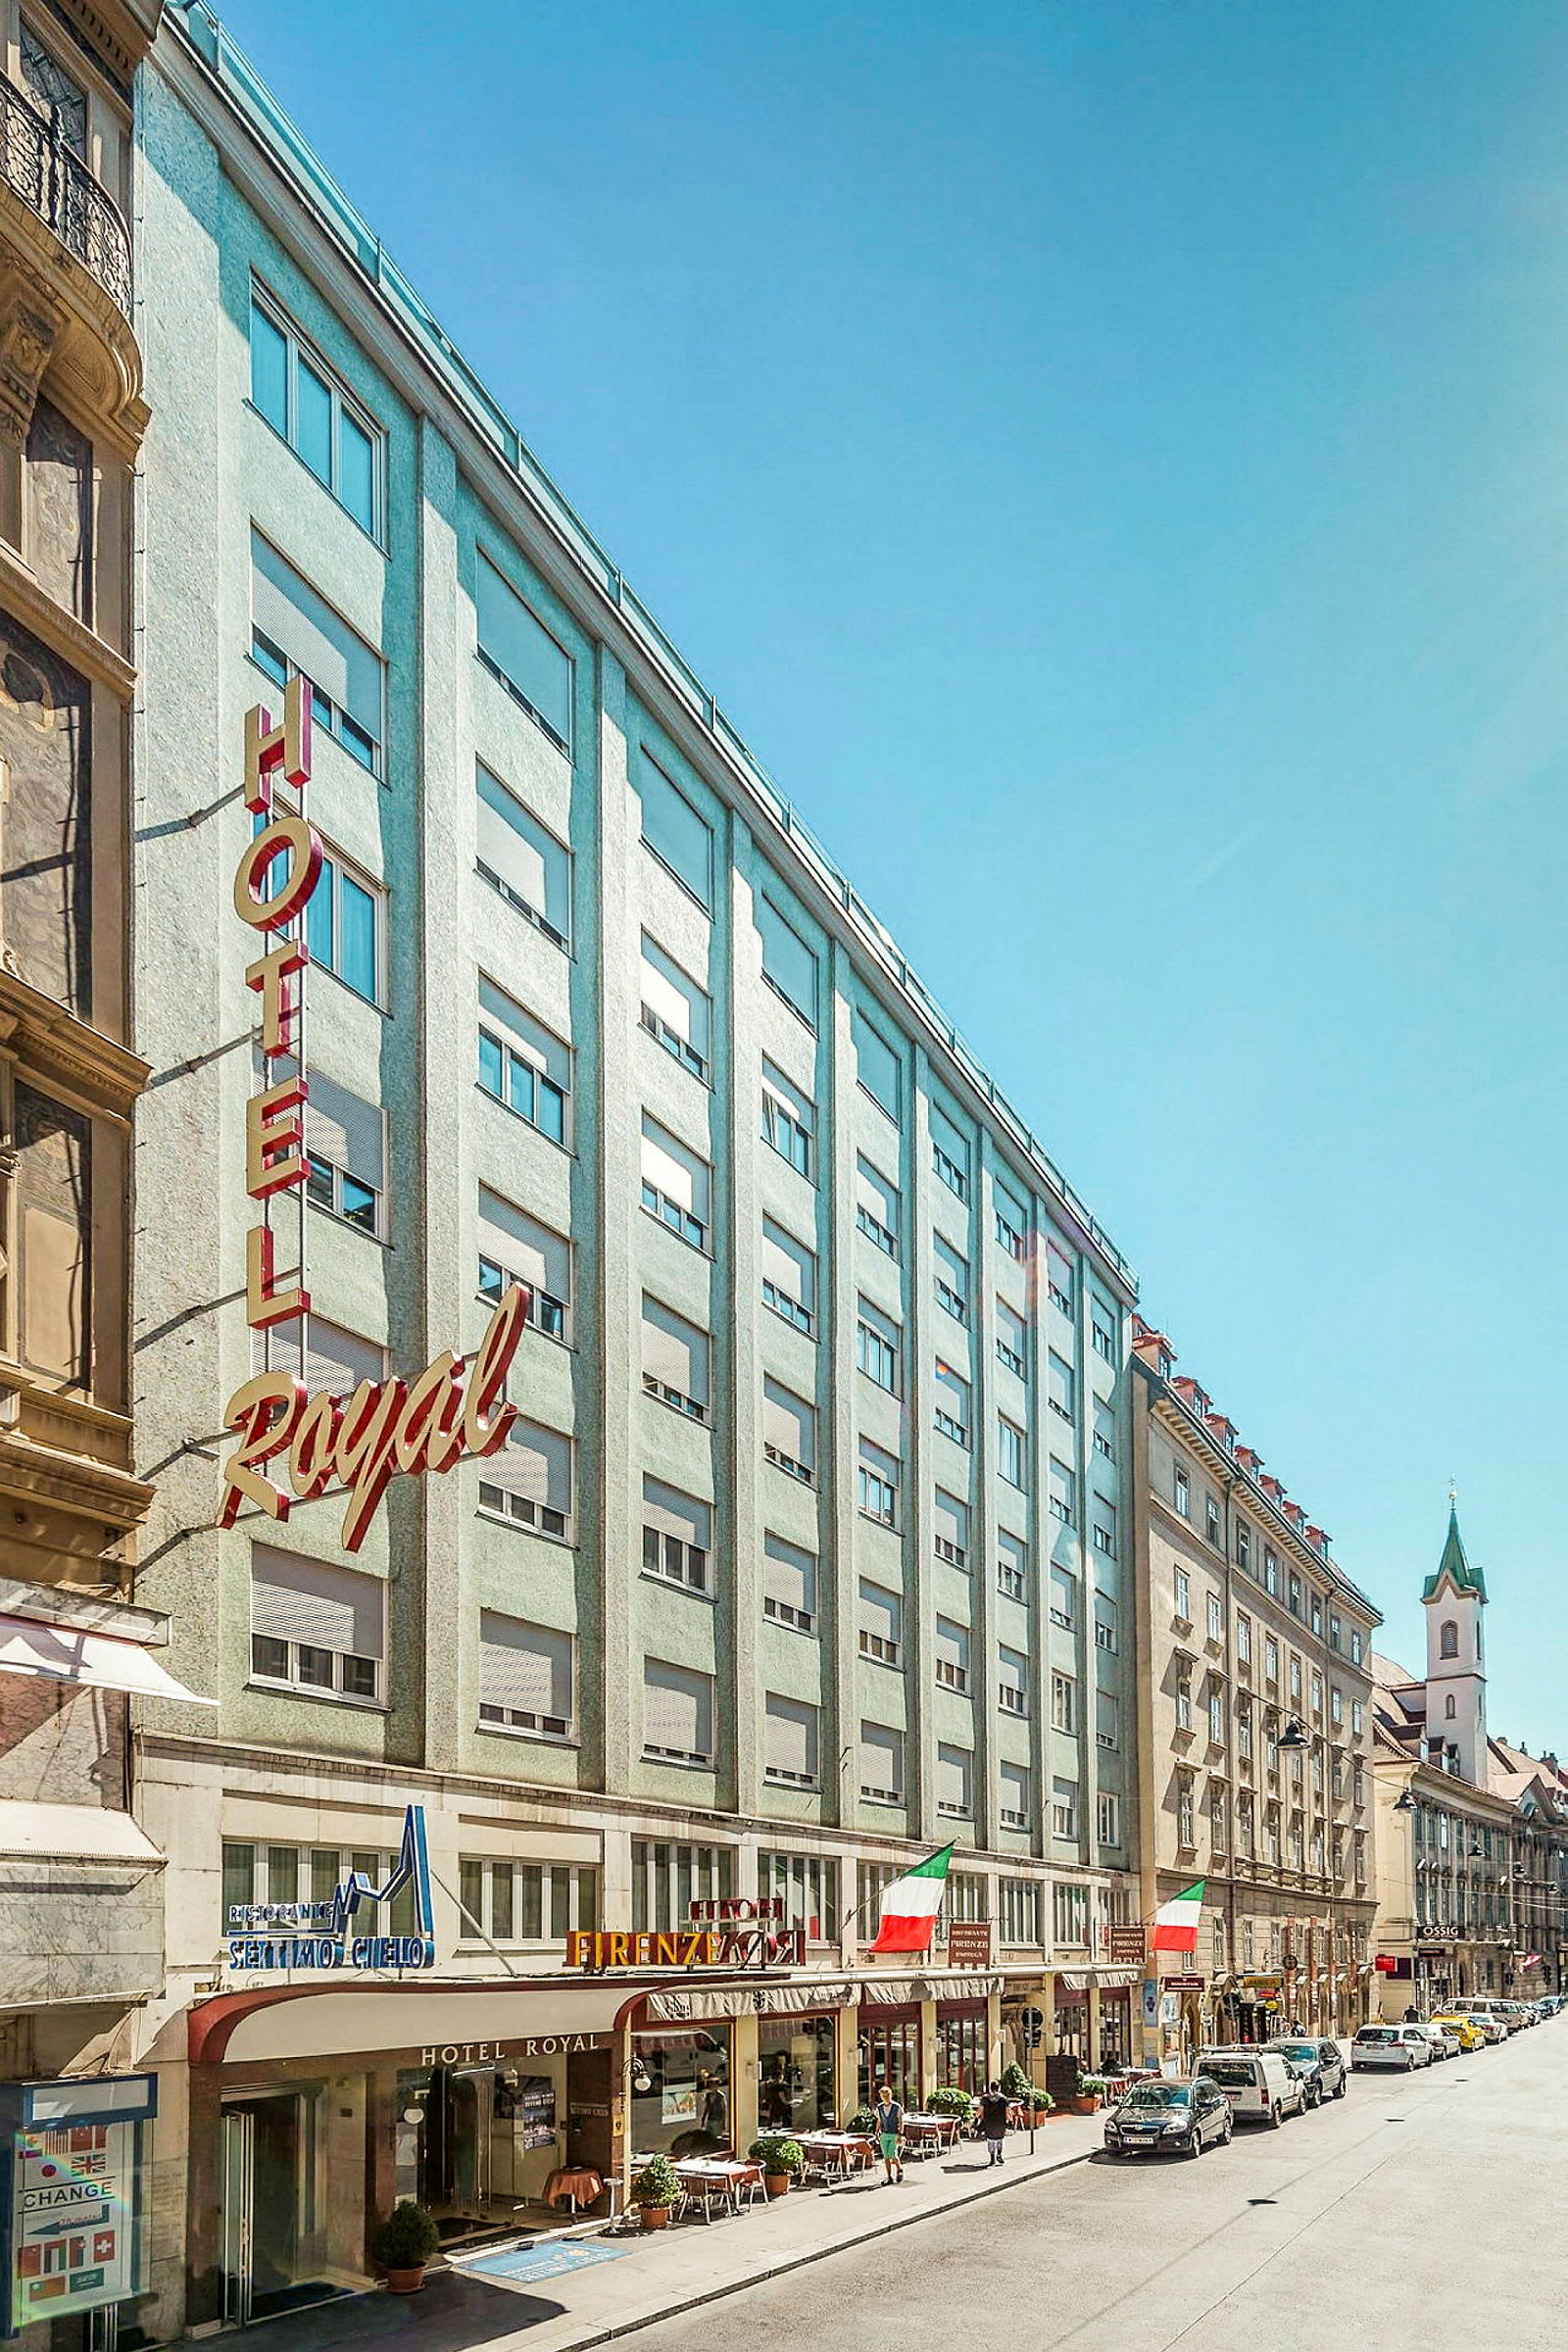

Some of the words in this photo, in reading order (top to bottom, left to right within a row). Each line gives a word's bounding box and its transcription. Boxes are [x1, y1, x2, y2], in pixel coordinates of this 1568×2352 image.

[233, 674, 324, 1332] HOTEL
[216, 1281, 530, 1553] Royal
[229, 1902, 334, 1922] RISTORANTE
[1423, 1926, 1459, 1936] OSSIG
[229, 1937, 344, 1970] SETTIMO
[352, 1936, 434, 1969] CIELO
[568, 1931, 722, 1966] FIRENZE
[420, 2041, 506, 2067] HOTEL
[525, 2034, 600, 2057] ROYAL
[24, 2180, 114, 2208] CHANGE
